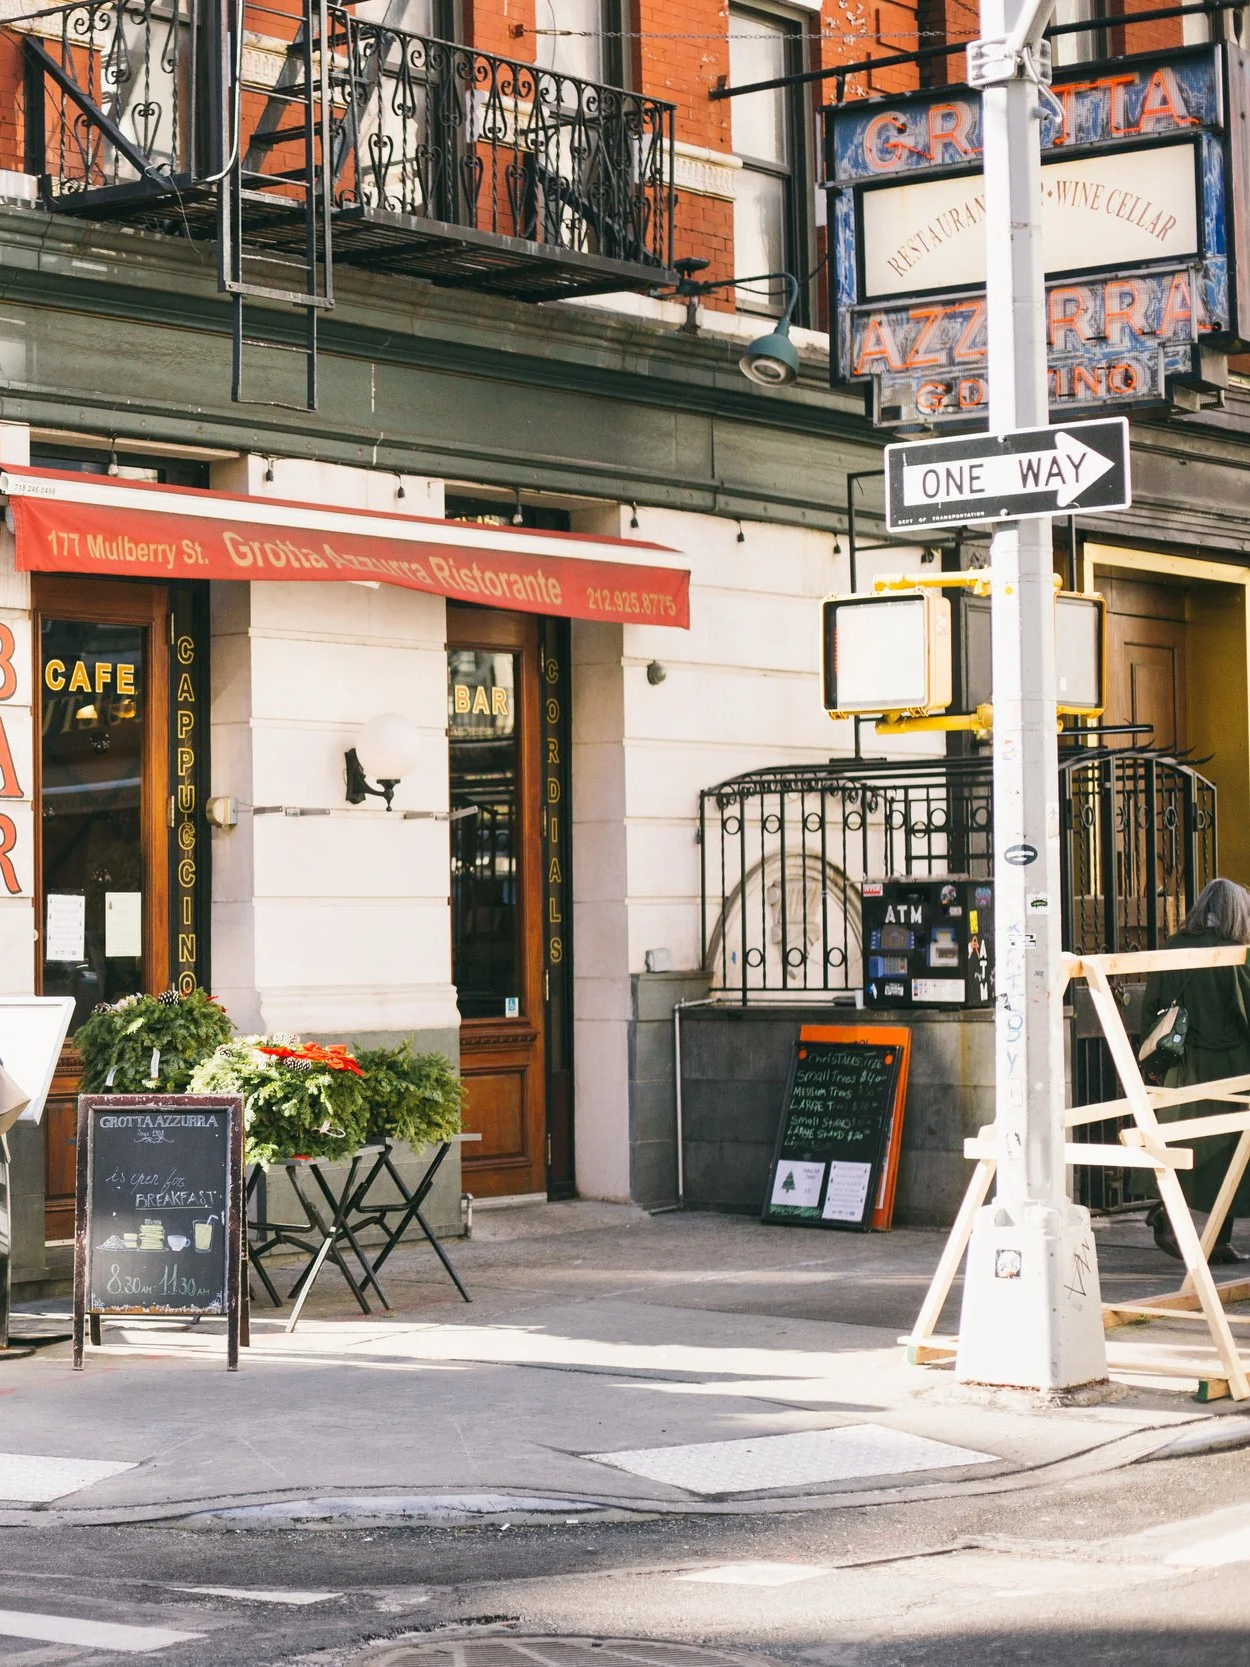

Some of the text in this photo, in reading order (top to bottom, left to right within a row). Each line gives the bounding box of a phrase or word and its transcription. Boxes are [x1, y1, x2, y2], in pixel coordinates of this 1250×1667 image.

[865, 67, 1199, 170] GRTTA
[887, 194, 986, 278] RESTAURAN
[1057, 180, 1105, 211] WINE
[1106, 188, 1177, 243] CELLAR
[854, 272, 1210, 376] AZZRRA
[922, 452, 1089, 499] ONE WAY
[932, 511, 985, 522] TRANSPORTATION
[47, 530, 678, 617] 177 Mulberry St. Grotta Azzurra Ristorante 212.925.8775
[44, 658, 136, 695] CAFE
[454, 684, 509, 716] BAR
[177, 636, 198, 997] CAPPUCCINO
[545, 658, 563, 964] CORDIALS
[885, 904, 922, 924] ATM
[100, 1114, 219, 1128] GROTTA AZZURRA
[790, 1098, 824, 1112] LARGE
[105, 1166, 186, 1196] is open for
[135, 1190, 215, 1208] BREAKFAST
